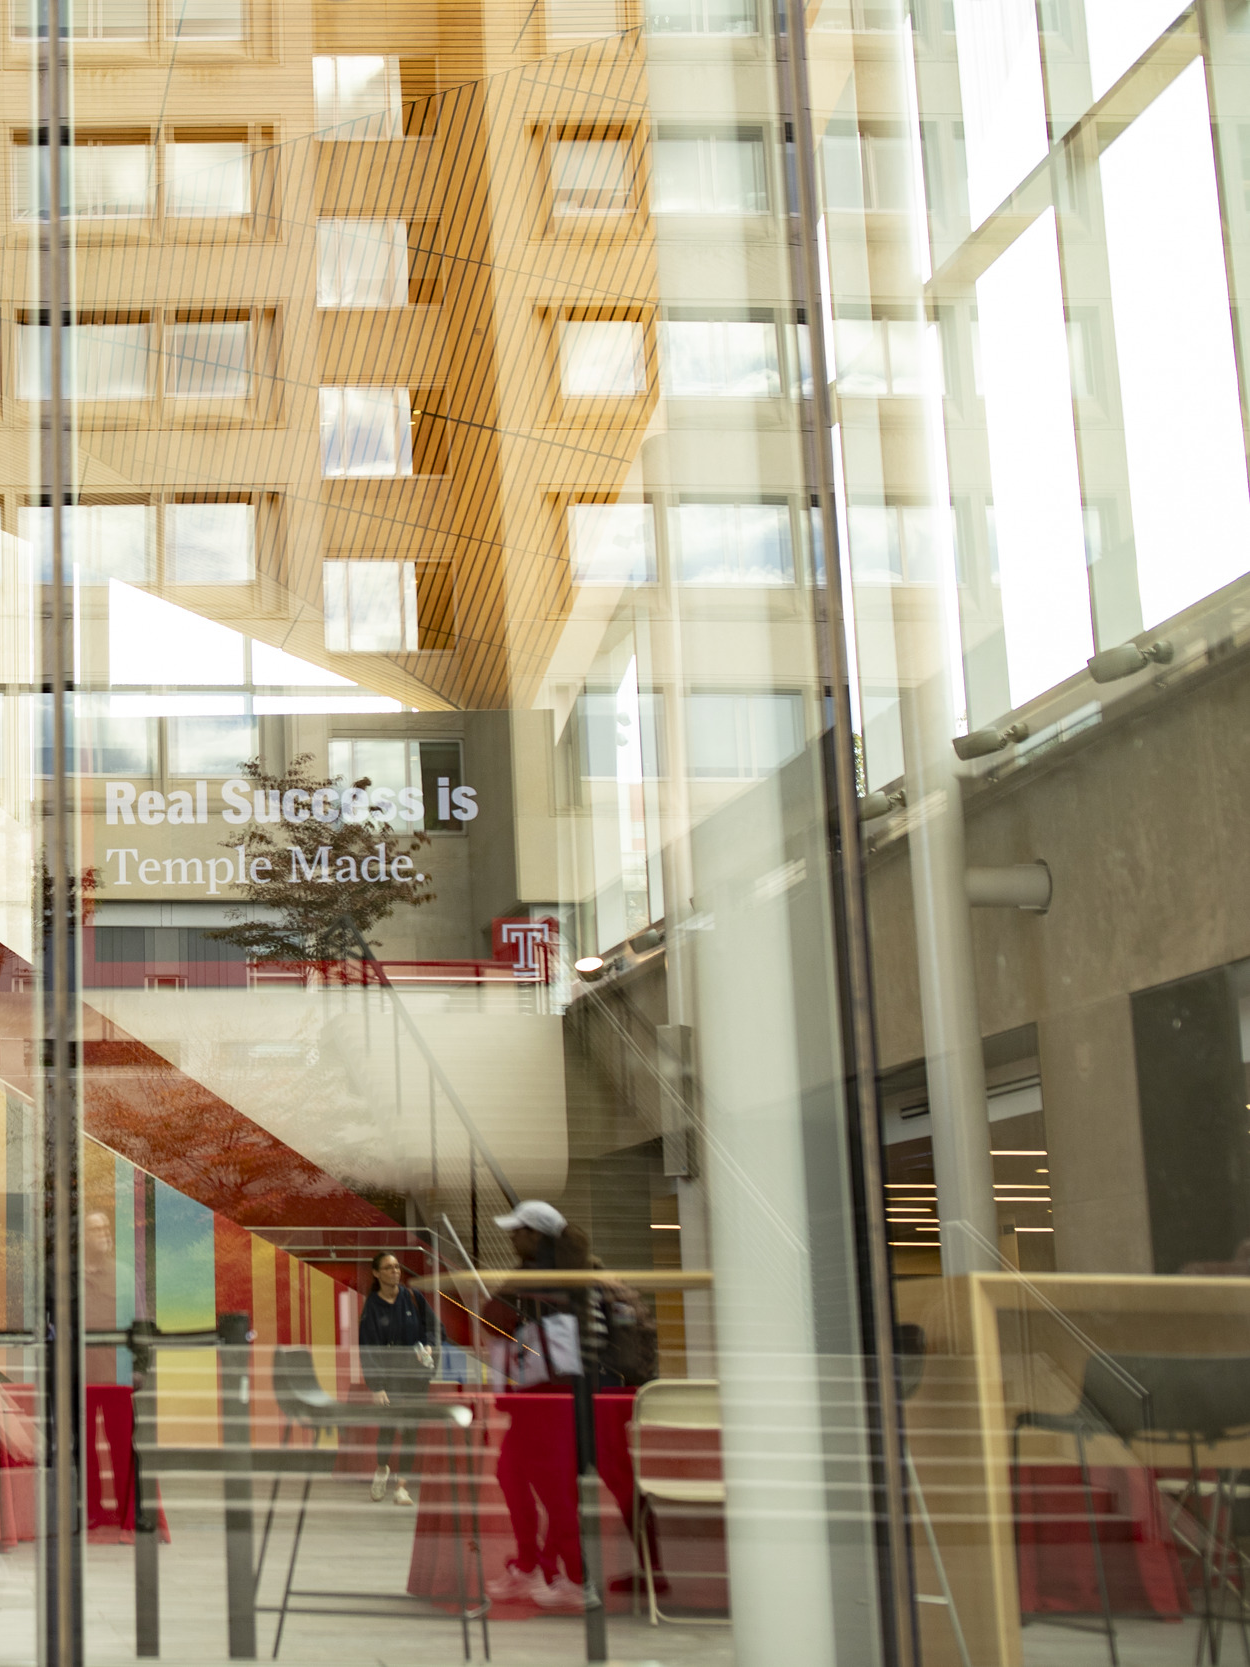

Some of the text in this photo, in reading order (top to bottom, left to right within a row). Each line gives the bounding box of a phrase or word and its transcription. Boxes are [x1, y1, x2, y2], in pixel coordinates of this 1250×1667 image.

[105, 777, 479, 825] Real Success is
[106, 843, 425, 894] Temple Made.
